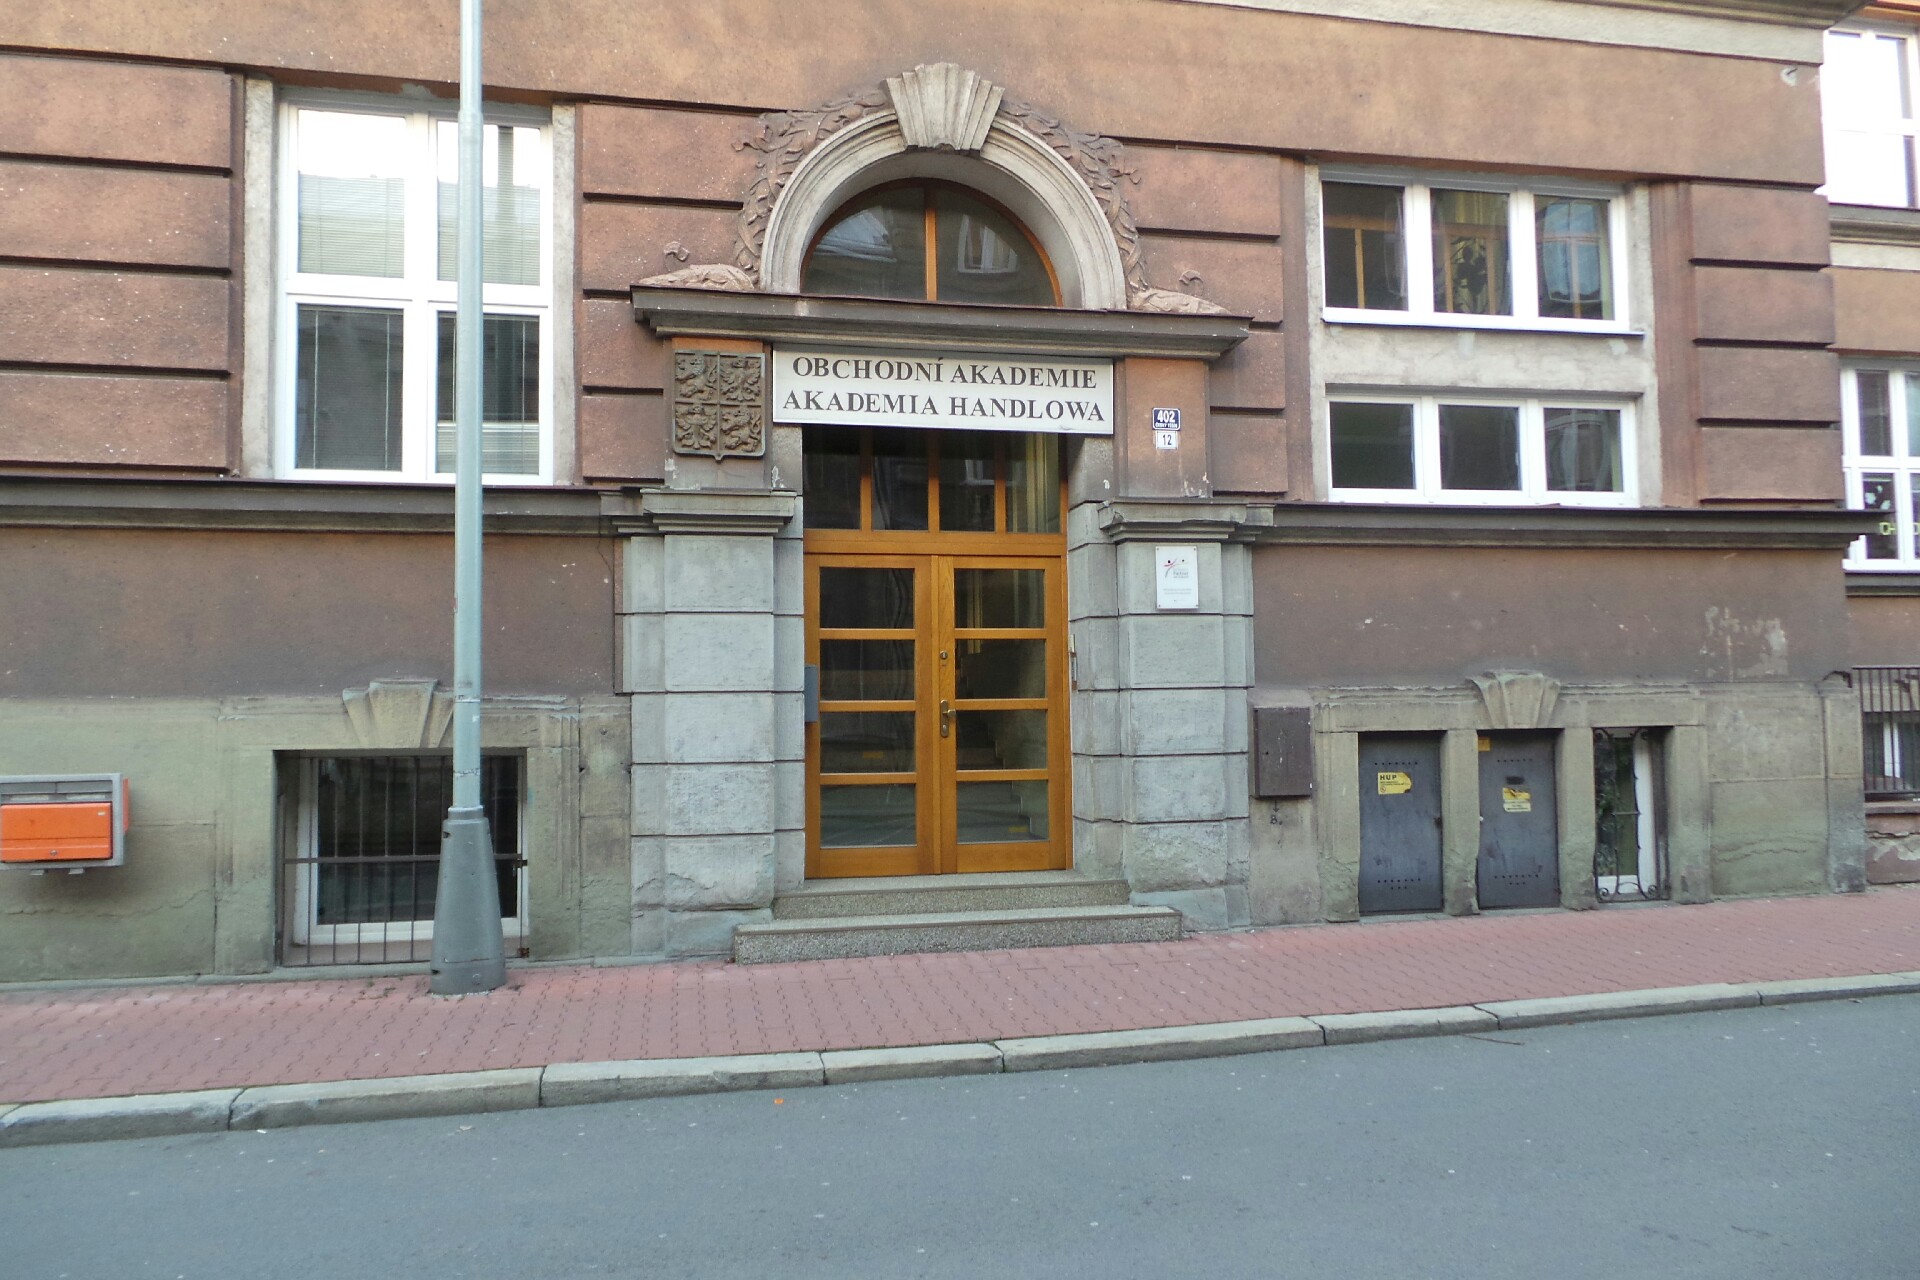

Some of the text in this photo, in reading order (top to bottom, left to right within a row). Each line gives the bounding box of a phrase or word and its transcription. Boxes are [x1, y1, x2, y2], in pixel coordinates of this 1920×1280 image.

[792, 357, 1097, 389] OBCHODNÍ AKADEMIE
[782, 390, 1105, 422] AKADEMIA HANDLOWA
[1157, 410, 1176, 423] 402
[1162, 434, 1172, 446] 12
